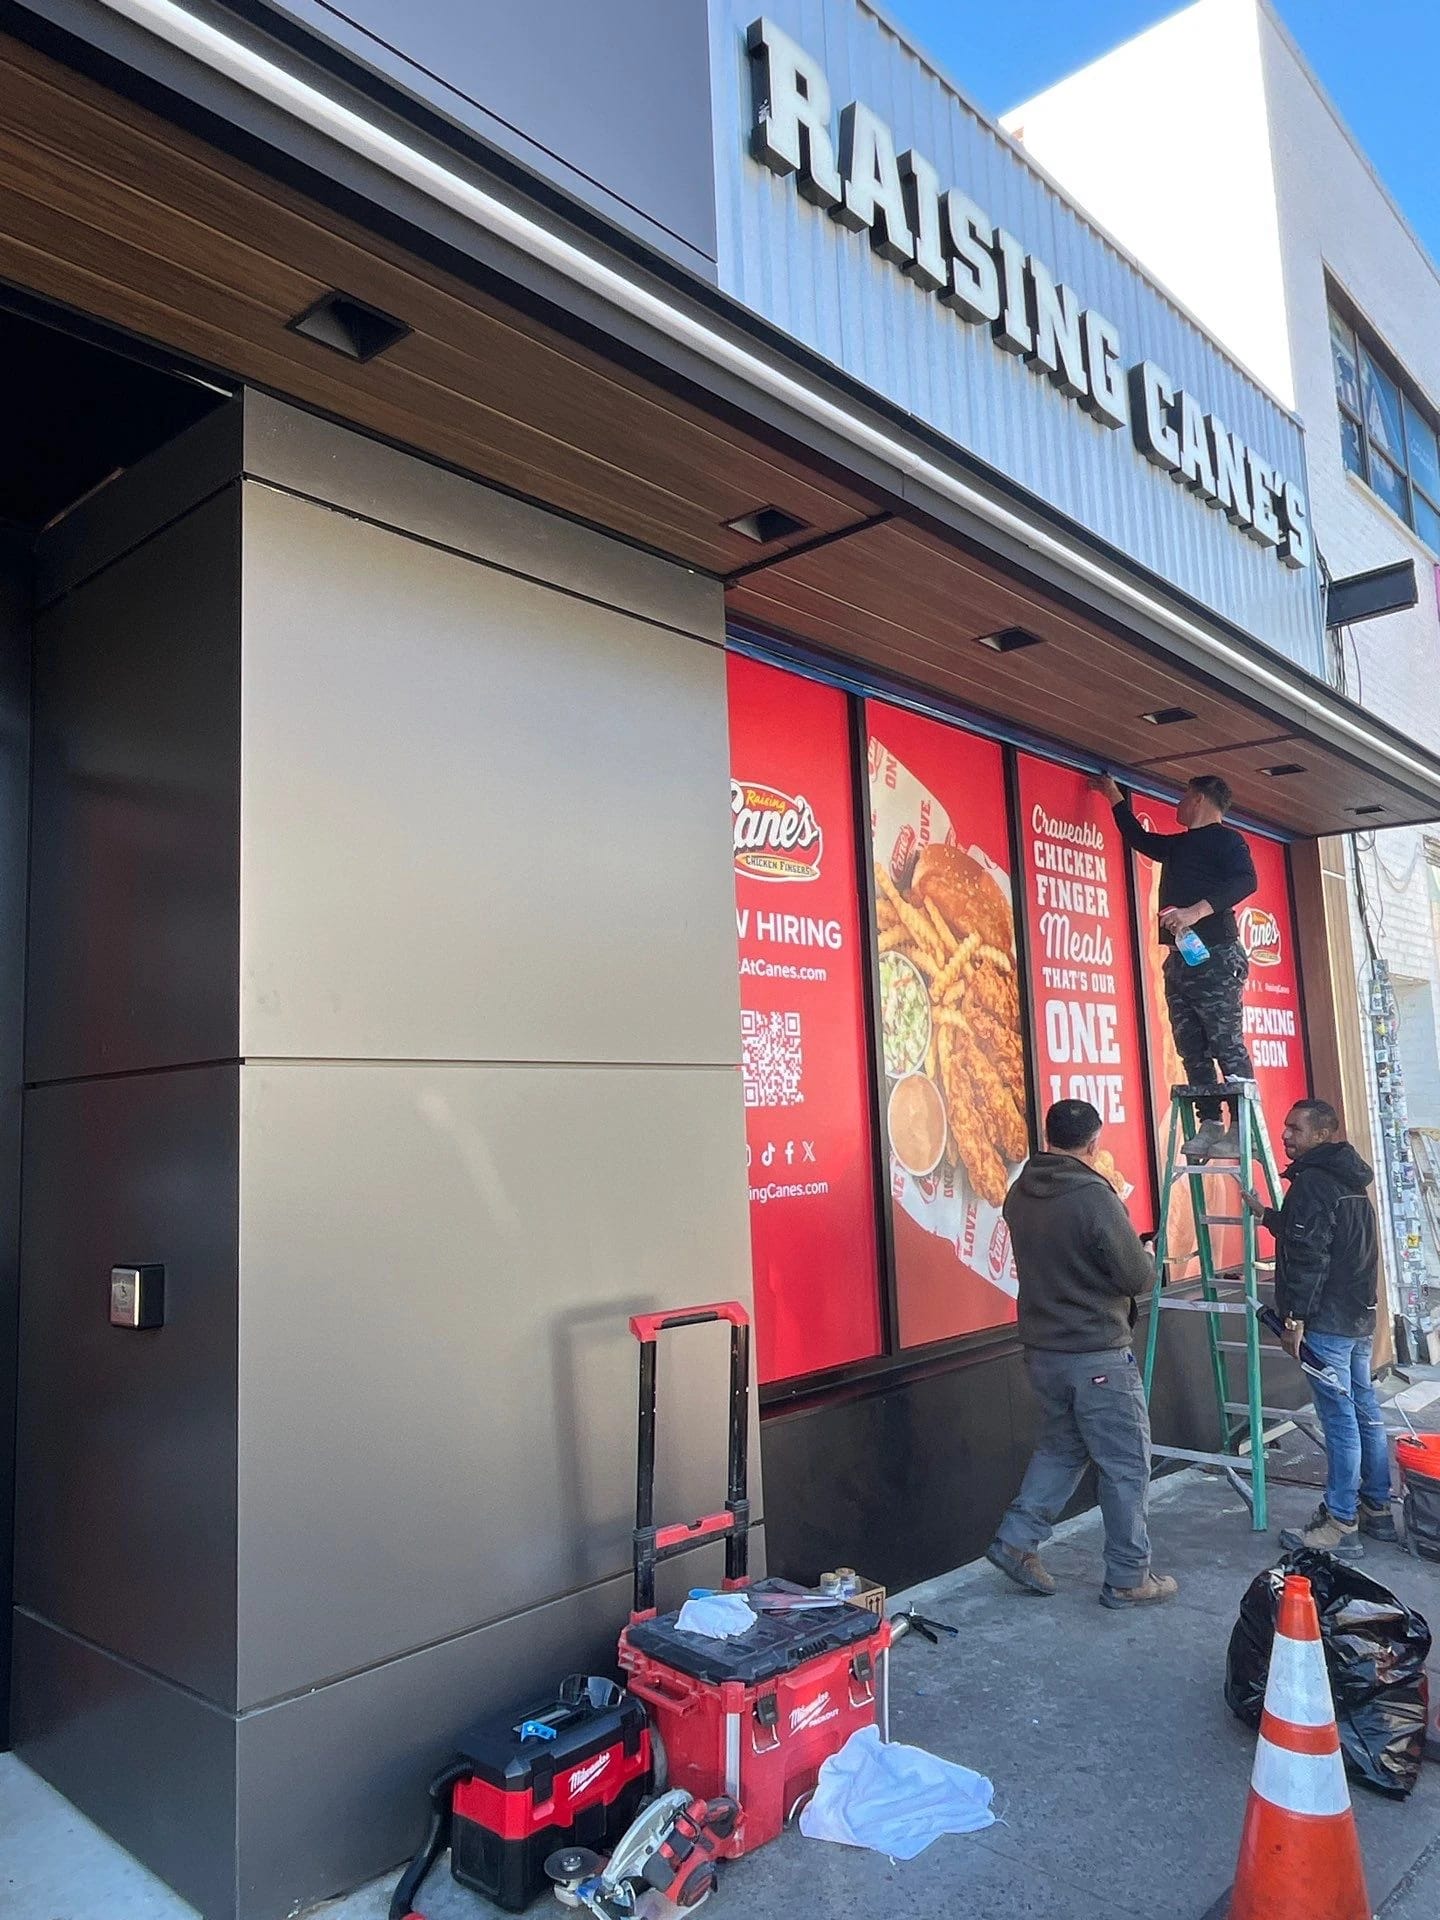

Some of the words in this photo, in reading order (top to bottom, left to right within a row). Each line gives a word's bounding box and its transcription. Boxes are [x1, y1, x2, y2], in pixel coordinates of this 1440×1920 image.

[748, 17, 1126, 430] RAISING
[1128, 360, 1310, 570] CANE'S
[885, 752, 897, 790] ON
[747, 790, 786, 813] Raising
[1032, 804, 1105, 851] Craveable
[1033, 840, 1107, 883] CHICKEN
[1035, 874, 1110, 918] FINGER
[757, 911, 842, 950] HIRING
[1039, 911, 1114, 967] Meals
[738, 957, 828, 982] AtCanes.com
[1042, 967, 1089, 992] THAT'S
[1091, 973, 1116, 995] OUR
[1045, 1000, 1121, 1065] ONE
[1252, 1039, 1289, 1068] SOON
[749, 1181, 829, 1204] ingCanes.com
[963, 1203, 978, 1258] LOVE
